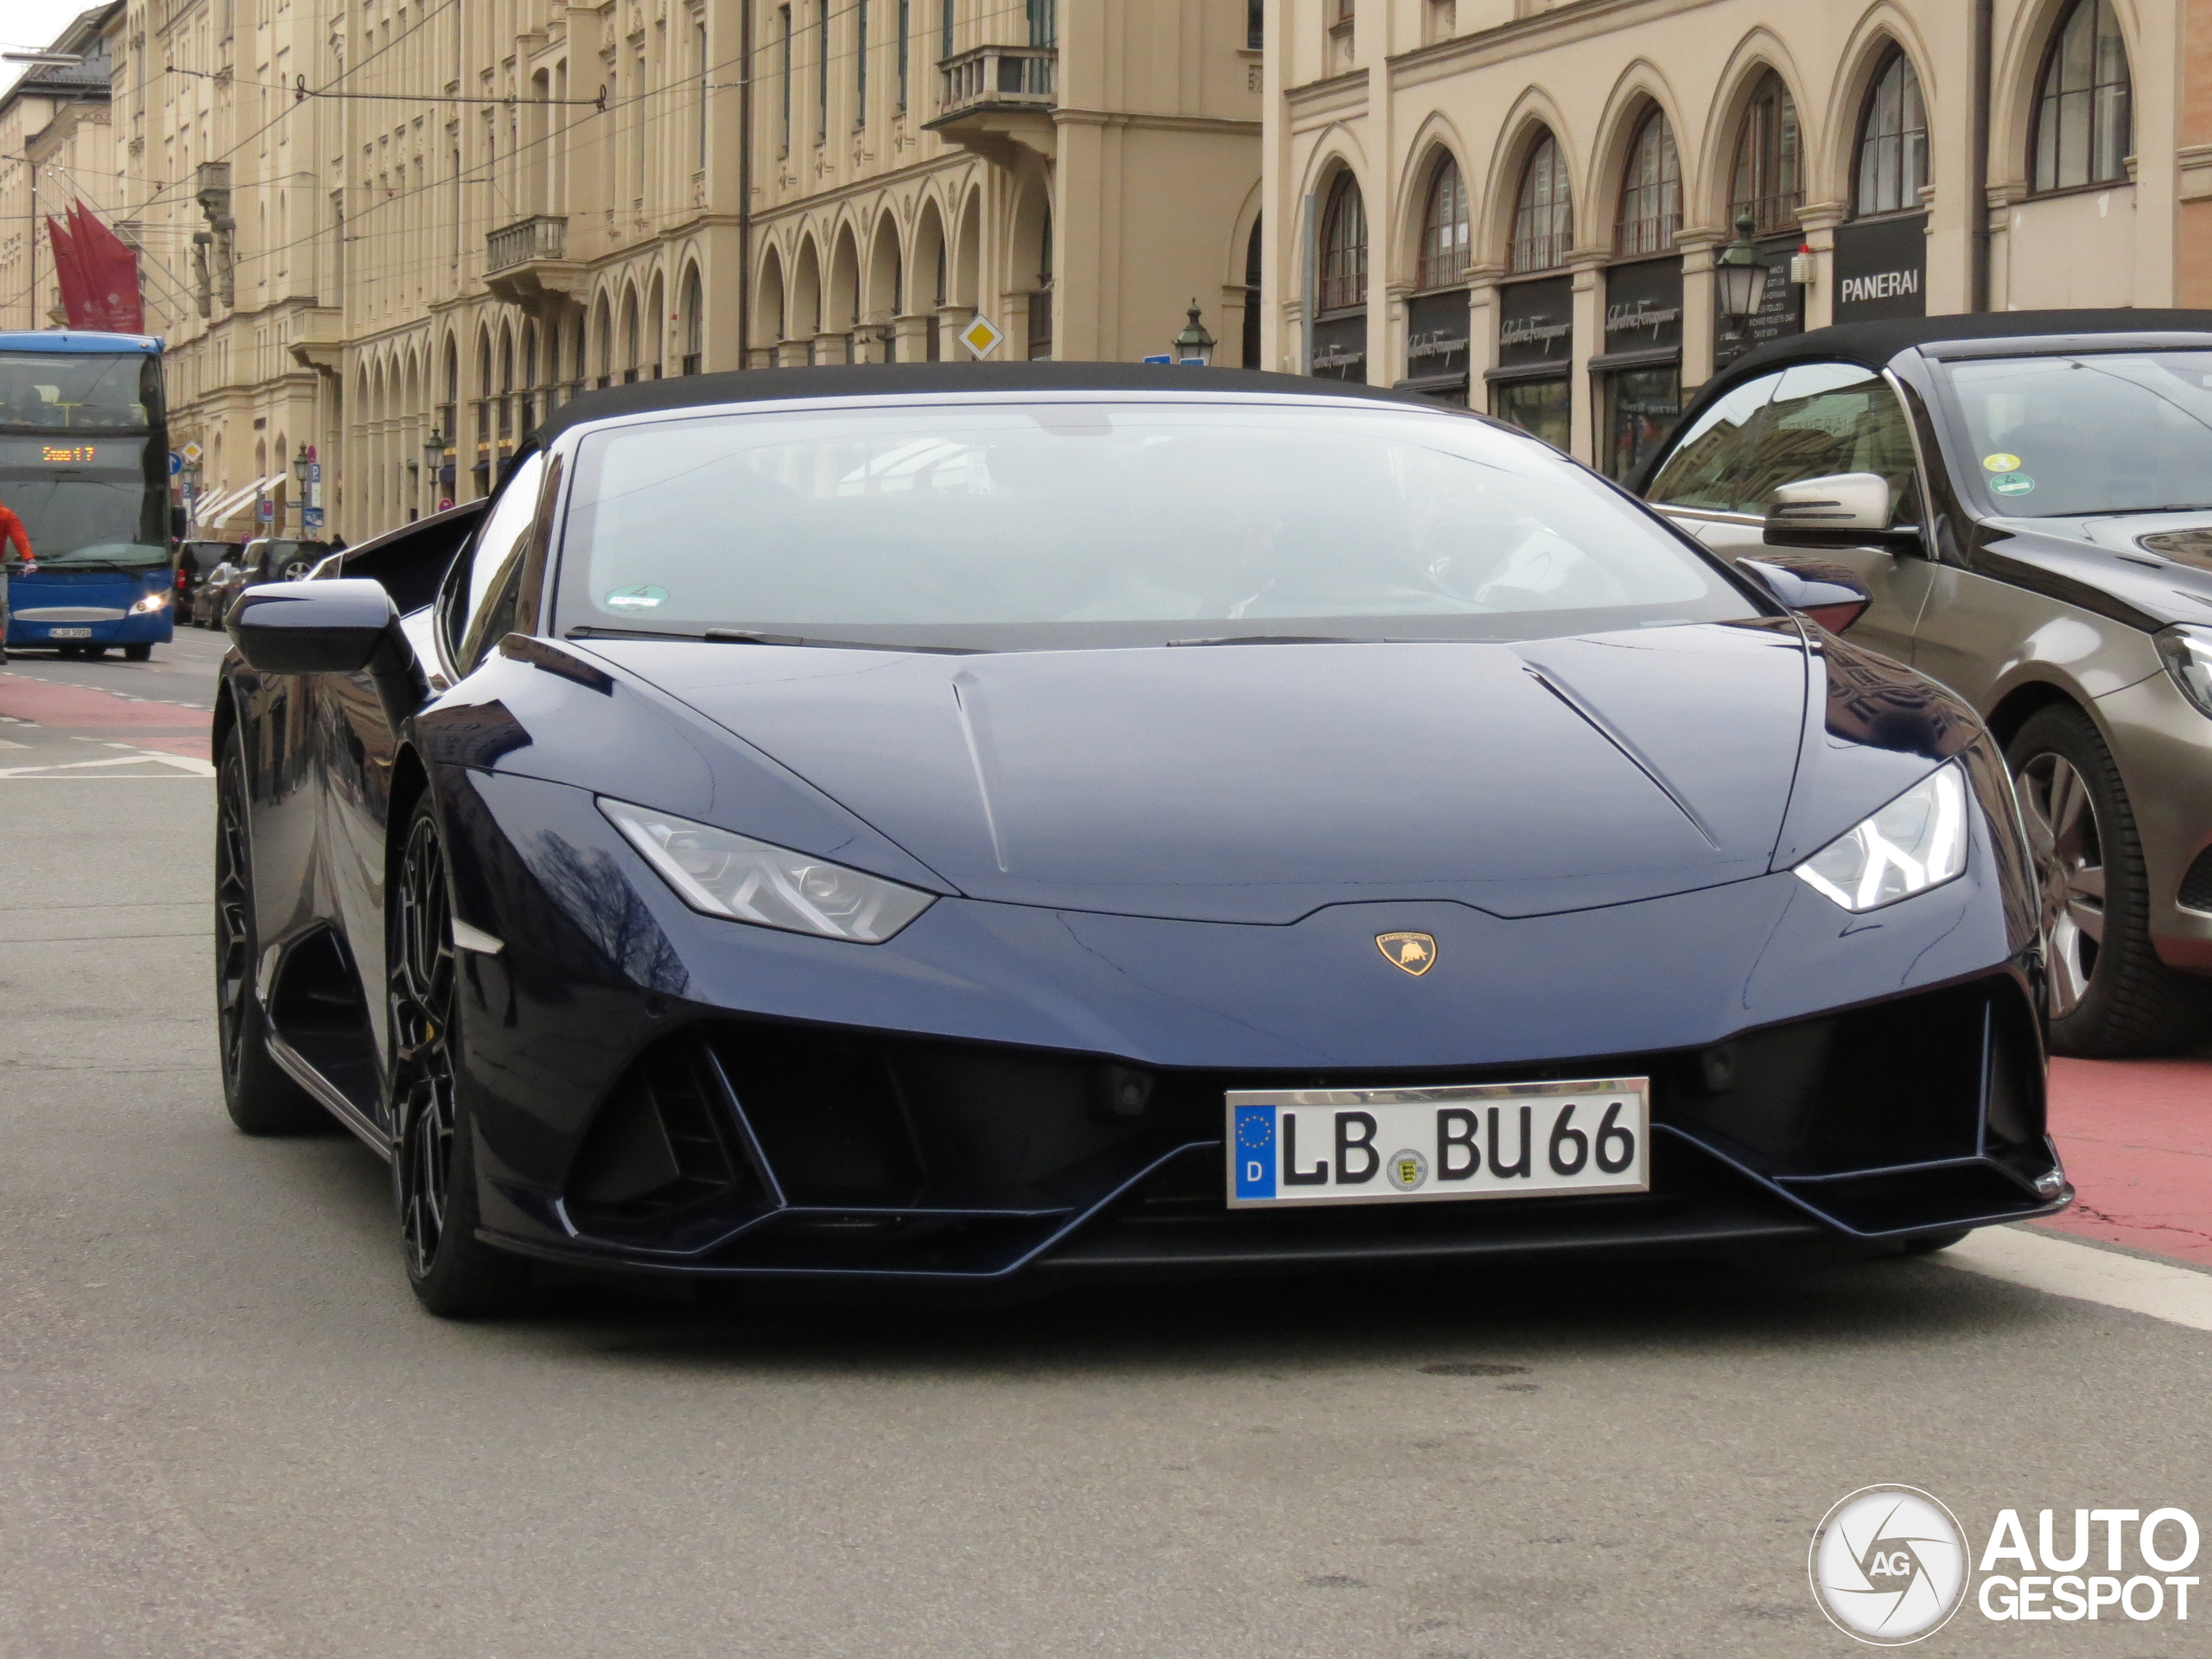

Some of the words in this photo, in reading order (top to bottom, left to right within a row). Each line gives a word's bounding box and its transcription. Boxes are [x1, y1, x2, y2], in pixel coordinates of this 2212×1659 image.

[1842, 270, 1918, 303] PANERAI
[2005, 474, 2017, 484] 4
[631, 585, 650, 597] 4
[1381, 934, 1430, 943] LAMBORGHINI
[1282, 1111, 1381, 1185] LB
[1436, 1106, 1531, 1181] BU
[1548, 1103, 1636, 1176] 66
[1247, 1161, 1263, 1182] D
